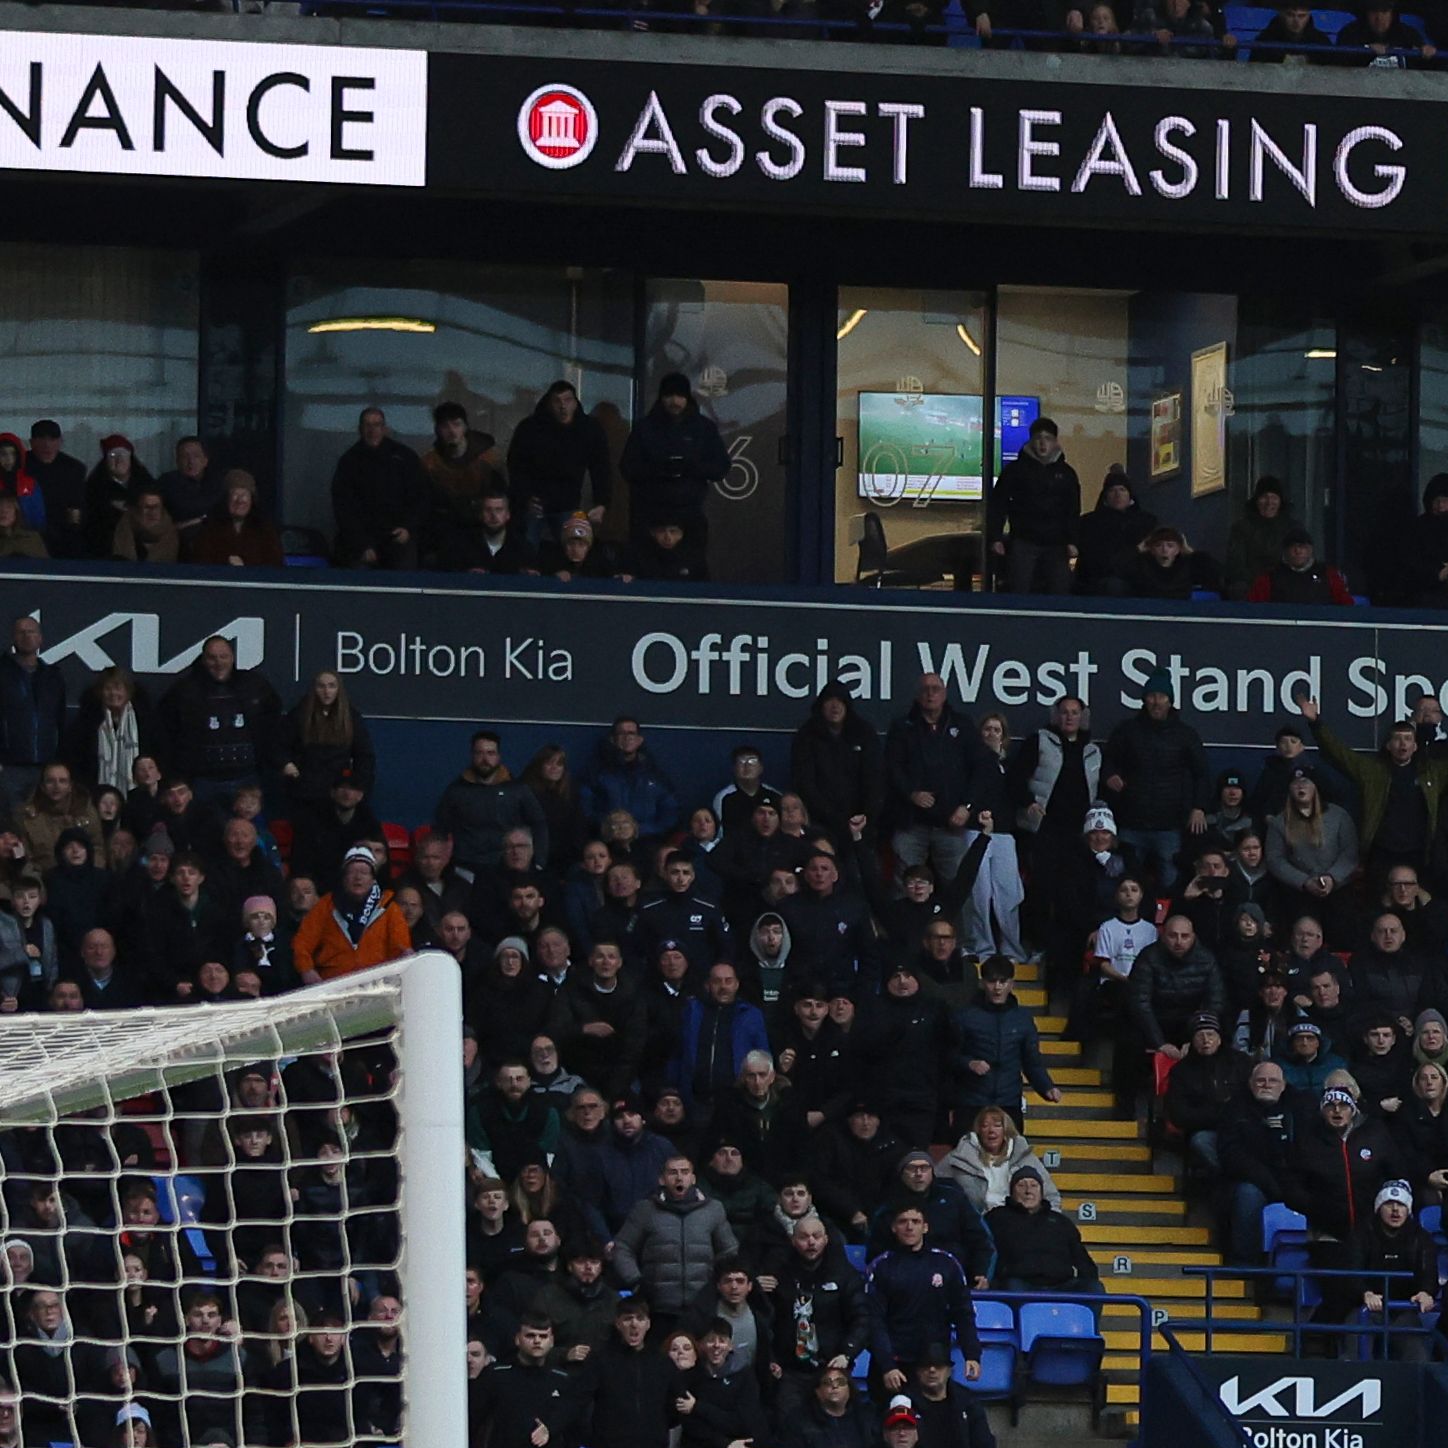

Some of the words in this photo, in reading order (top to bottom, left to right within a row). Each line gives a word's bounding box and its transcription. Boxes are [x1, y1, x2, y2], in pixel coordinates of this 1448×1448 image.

[614, 89, 923, 186] ASSET
[968, 106, 1408, 208] LEASING
[337, 631, 485, 680] Bolton
[505, 638, 573, 682] Kia
[631, 632, 890, 701] Official
[917, 642, 1097, 708] West
[1121, 647, 1321, 716] Stand
[1047, 1152, 1059, 1166] T
[1083, 1204, 1093, 1218] S
[1117, 1257, 1128, 1271] R
[1154, 1310, 1164, 1323] P
[1220, 1375, 1381, 1418] KIA
